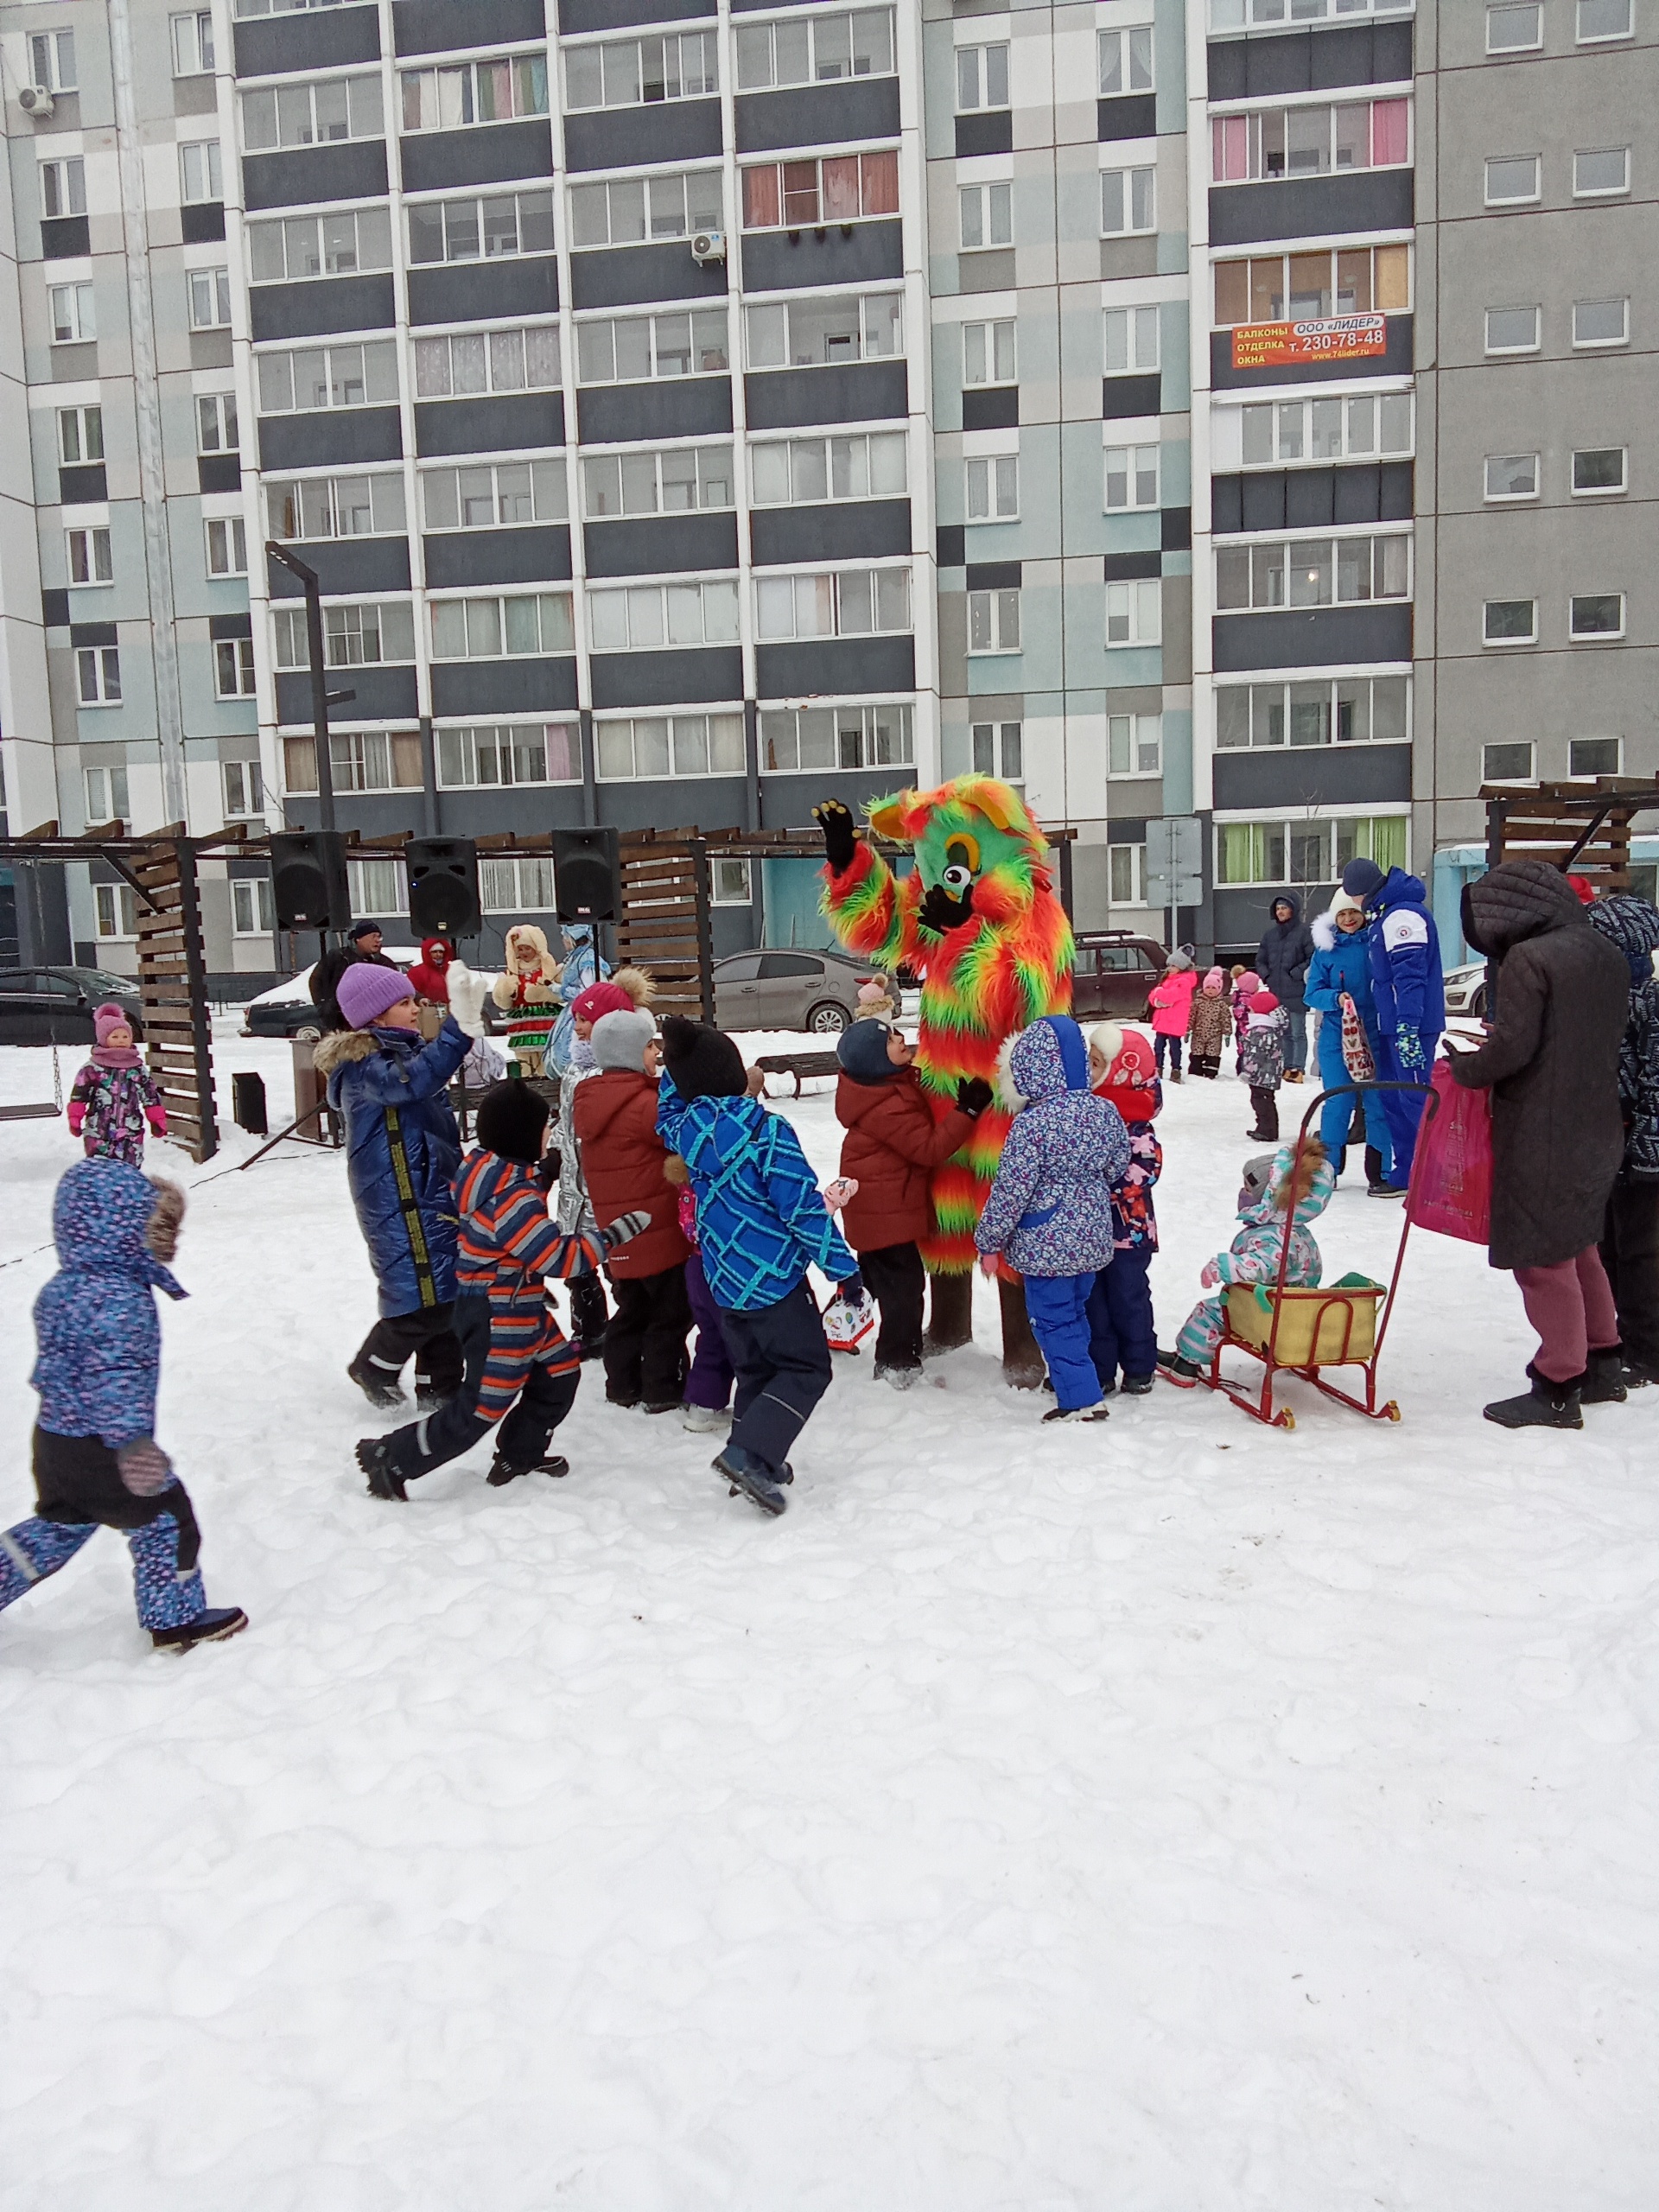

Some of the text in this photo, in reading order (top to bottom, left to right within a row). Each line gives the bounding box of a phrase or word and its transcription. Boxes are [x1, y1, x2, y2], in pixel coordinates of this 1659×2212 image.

[1297, 317, 1380, 334] ООО «ЛИДЕР»
[1236, 327, 1288, 339] БАЛКОНЫ
[1236, 340, 1285, 352] ОТДЕЛКА
[1302, 329, 1383, 352] 230-78-48
[1236, 355, 1266, 365] ОКНА
[1311, 349, 1370, 359] www.74lider.ru
